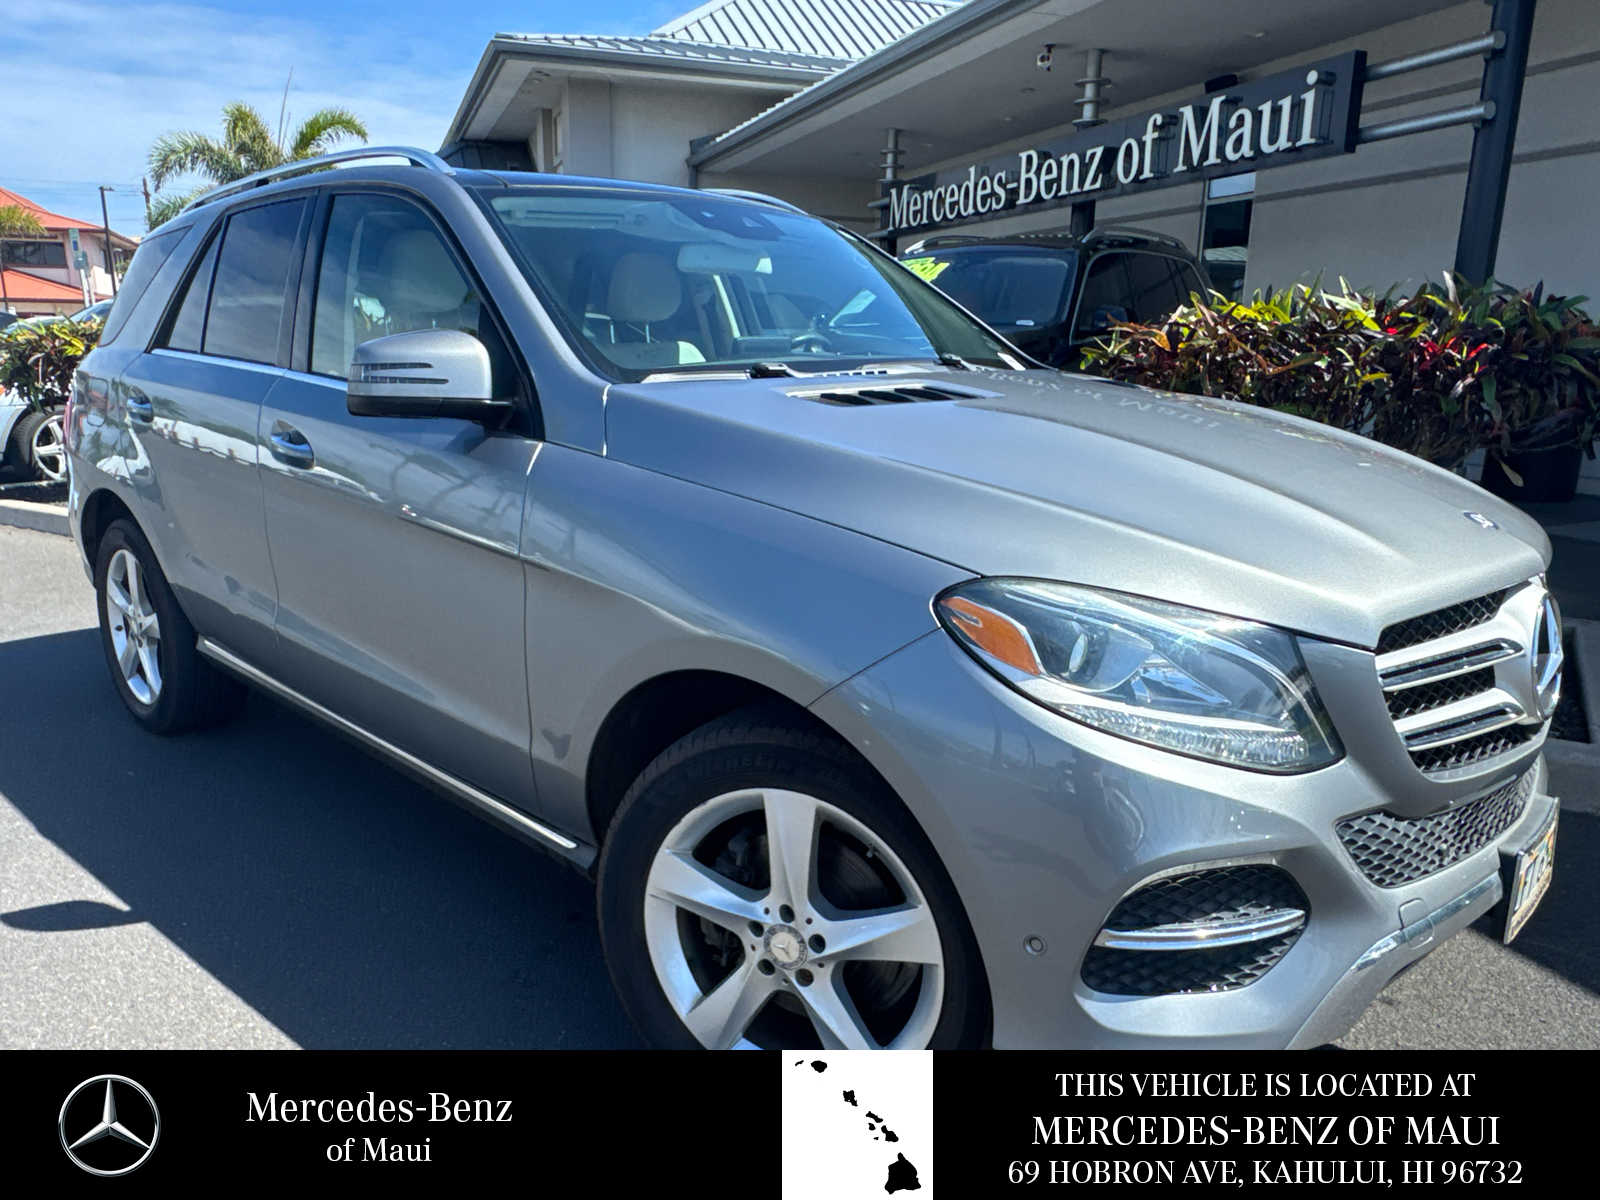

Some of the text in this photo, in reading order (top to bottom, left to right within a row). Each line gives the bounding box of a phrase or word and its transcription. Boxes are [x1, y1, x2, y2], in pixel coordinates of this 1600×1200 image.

[888, 69, 1319, 231] Mercedes-Benz of Maui
